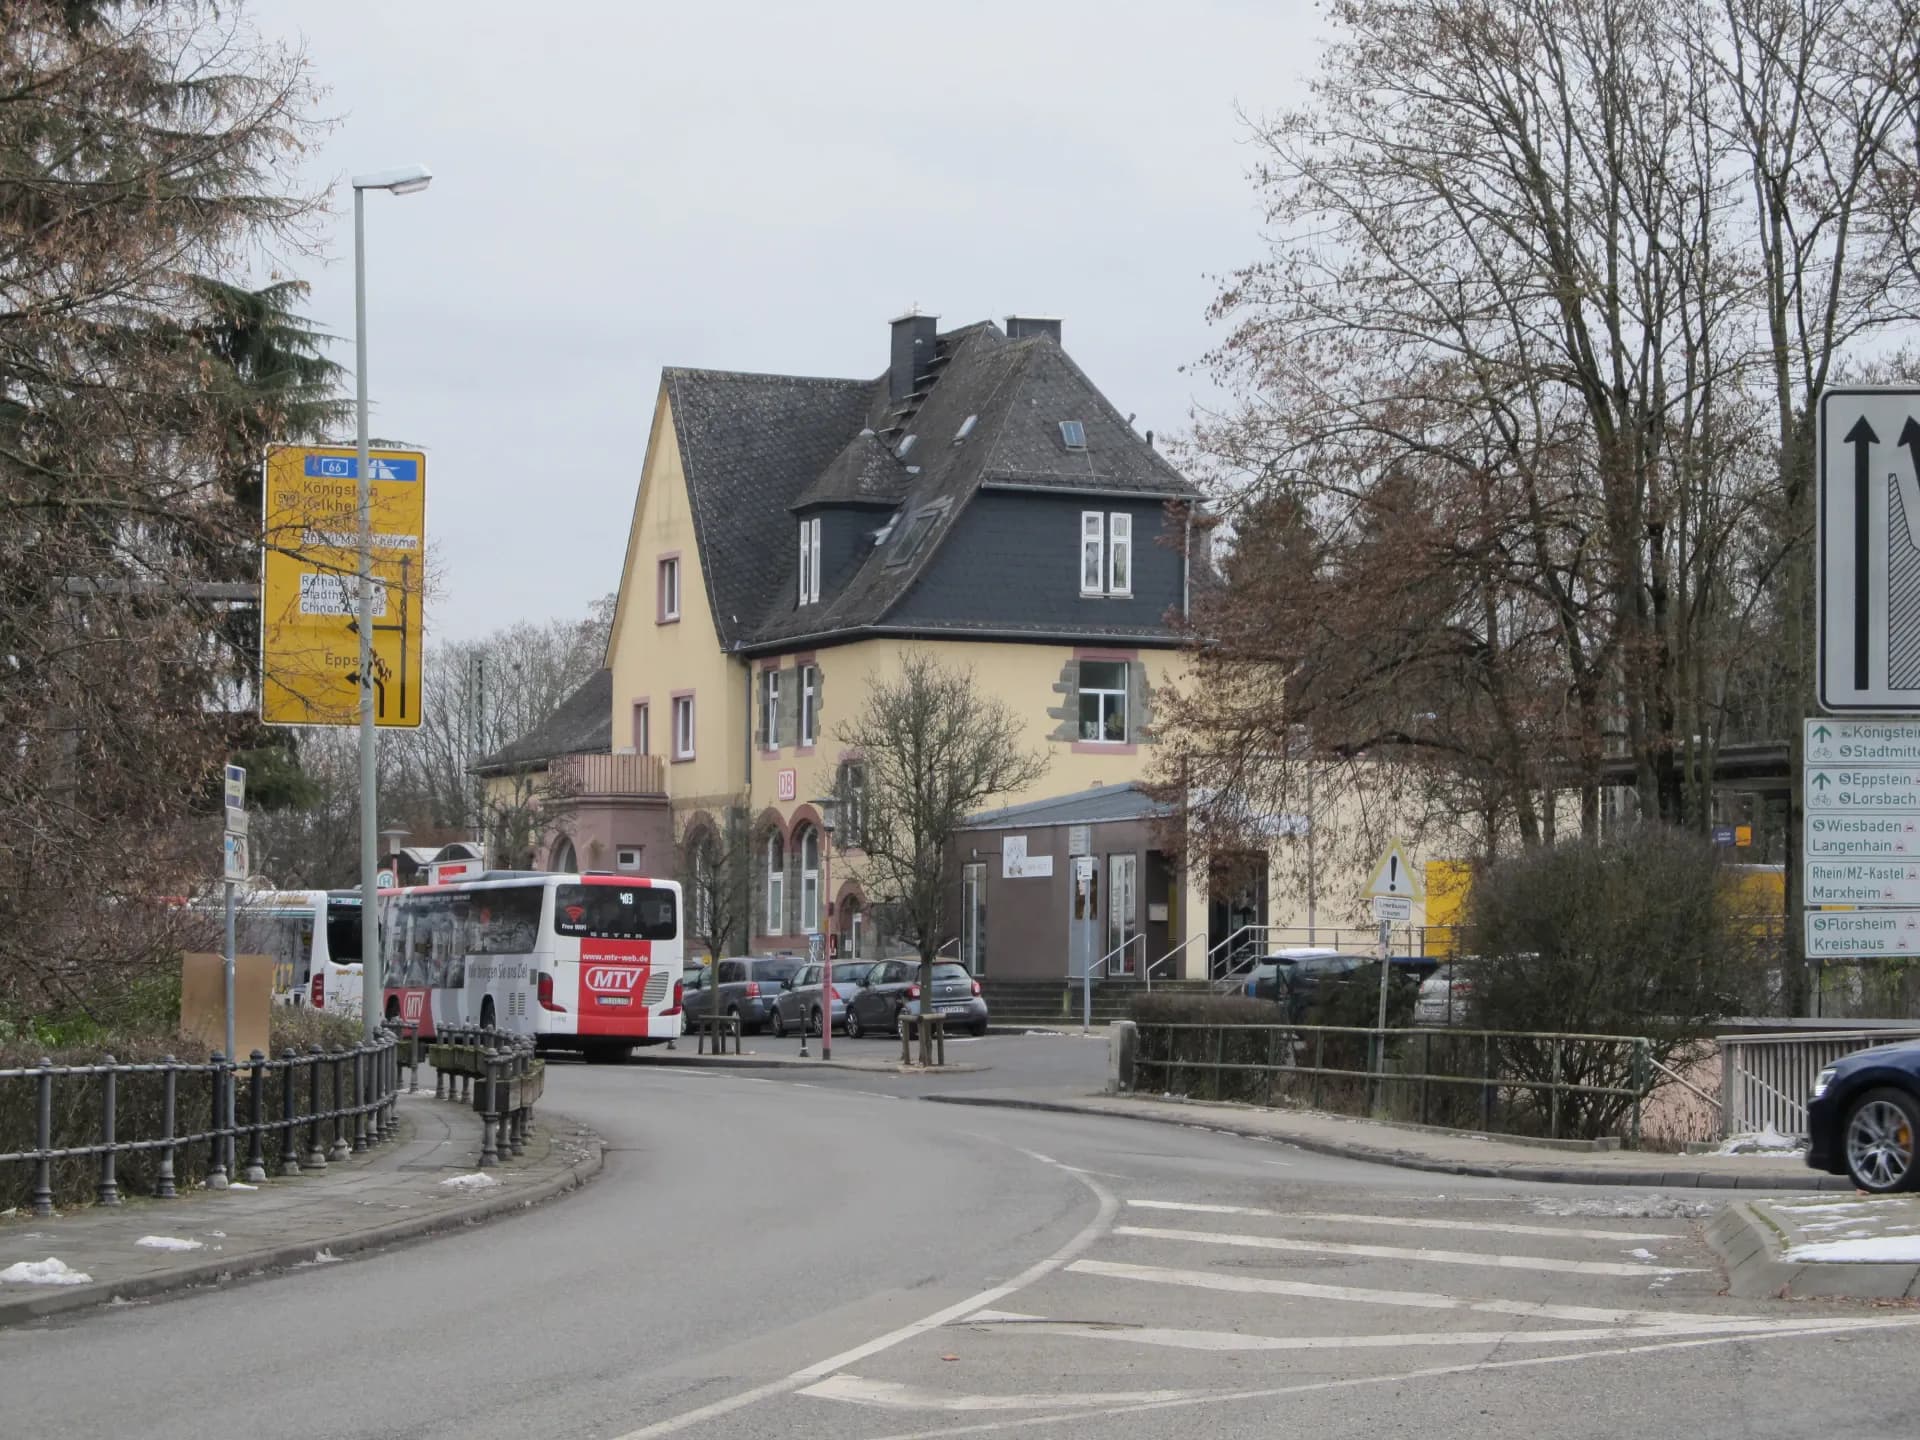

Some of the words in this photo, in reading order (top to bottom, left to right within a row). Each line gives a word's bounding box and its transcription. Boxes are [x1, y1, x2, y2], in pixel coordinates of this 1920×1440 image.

[328, 462, 342, 473] 66
[302, 576, 347, 587] Rathaus
[780, 774, 793, 795] DB
[1853, 773, 1911, 789] Eppstein
[1853, 792, 1917, 805] Lorsbach
[1827, 820, 1902, 833] Wiesbaden
[1812, 840, 1892, 854] Langenhain
[1812, 866, 1904, 880] Rhein/MZ-Kastel
[620, 893, 633, 904] 403
[1812, 886, 1881, 899] Marxheim
[1827, 918, 1897, 931] Flörsheim
[1815, 937, 1885, 951] Kreishaus
[582, 953, 649, 962] www.mtv-web.de
[593, 971, 642, 989] MTV
